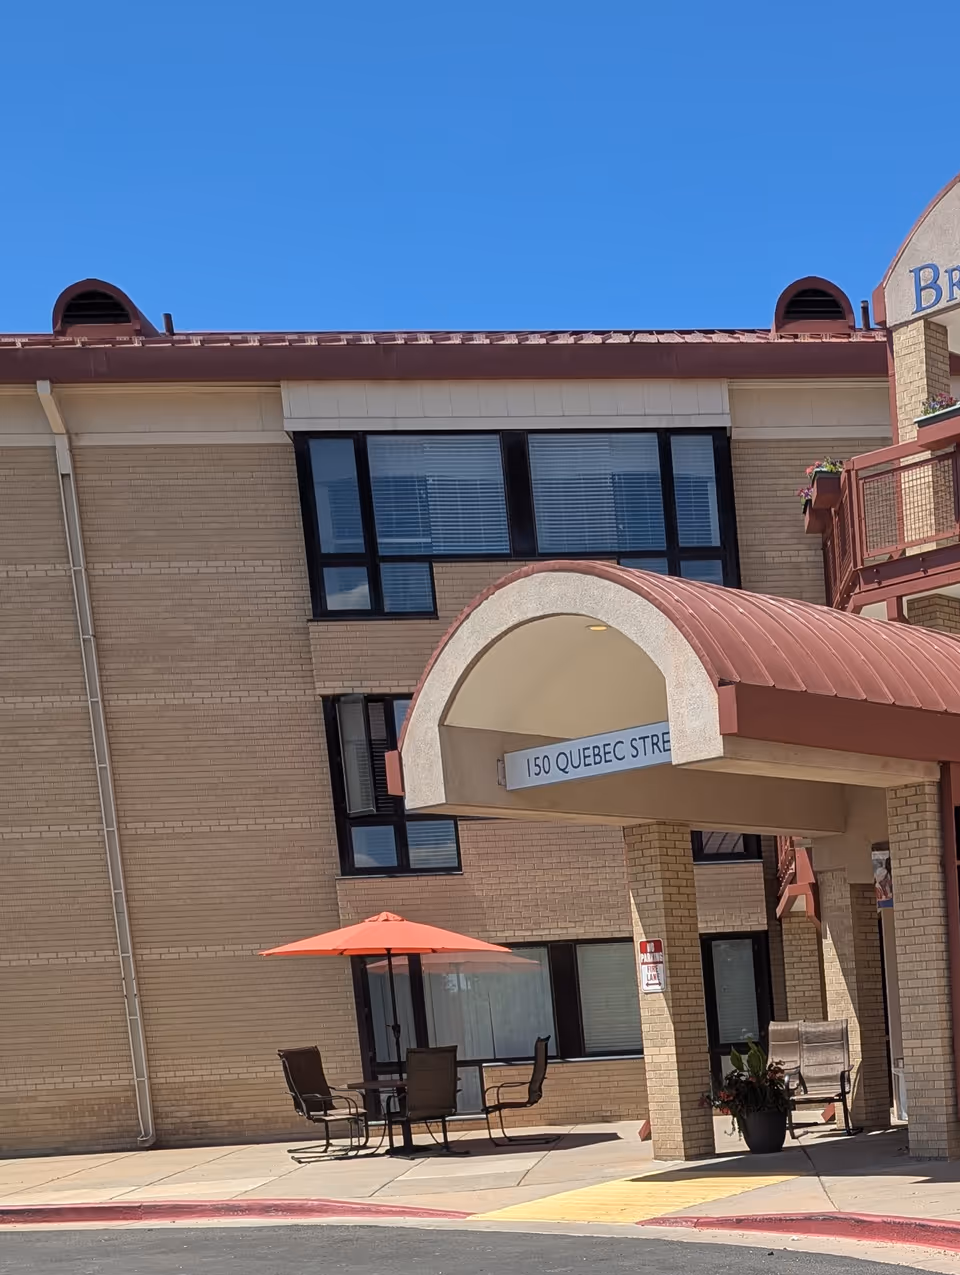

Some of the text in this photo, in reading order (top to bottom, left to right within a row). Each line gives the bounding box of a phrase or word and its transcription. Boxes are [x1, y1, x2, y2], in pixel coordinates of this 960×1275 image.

[526, 756, 551, 777] 150
[555, 740, 626, 775] QUEBEC
[647, 942, 655, 952] NO
[640, 952, 663, 963] PARKING
[647, 965, 658, 973] FIRE
[646, 973, 660, 982] LANE
